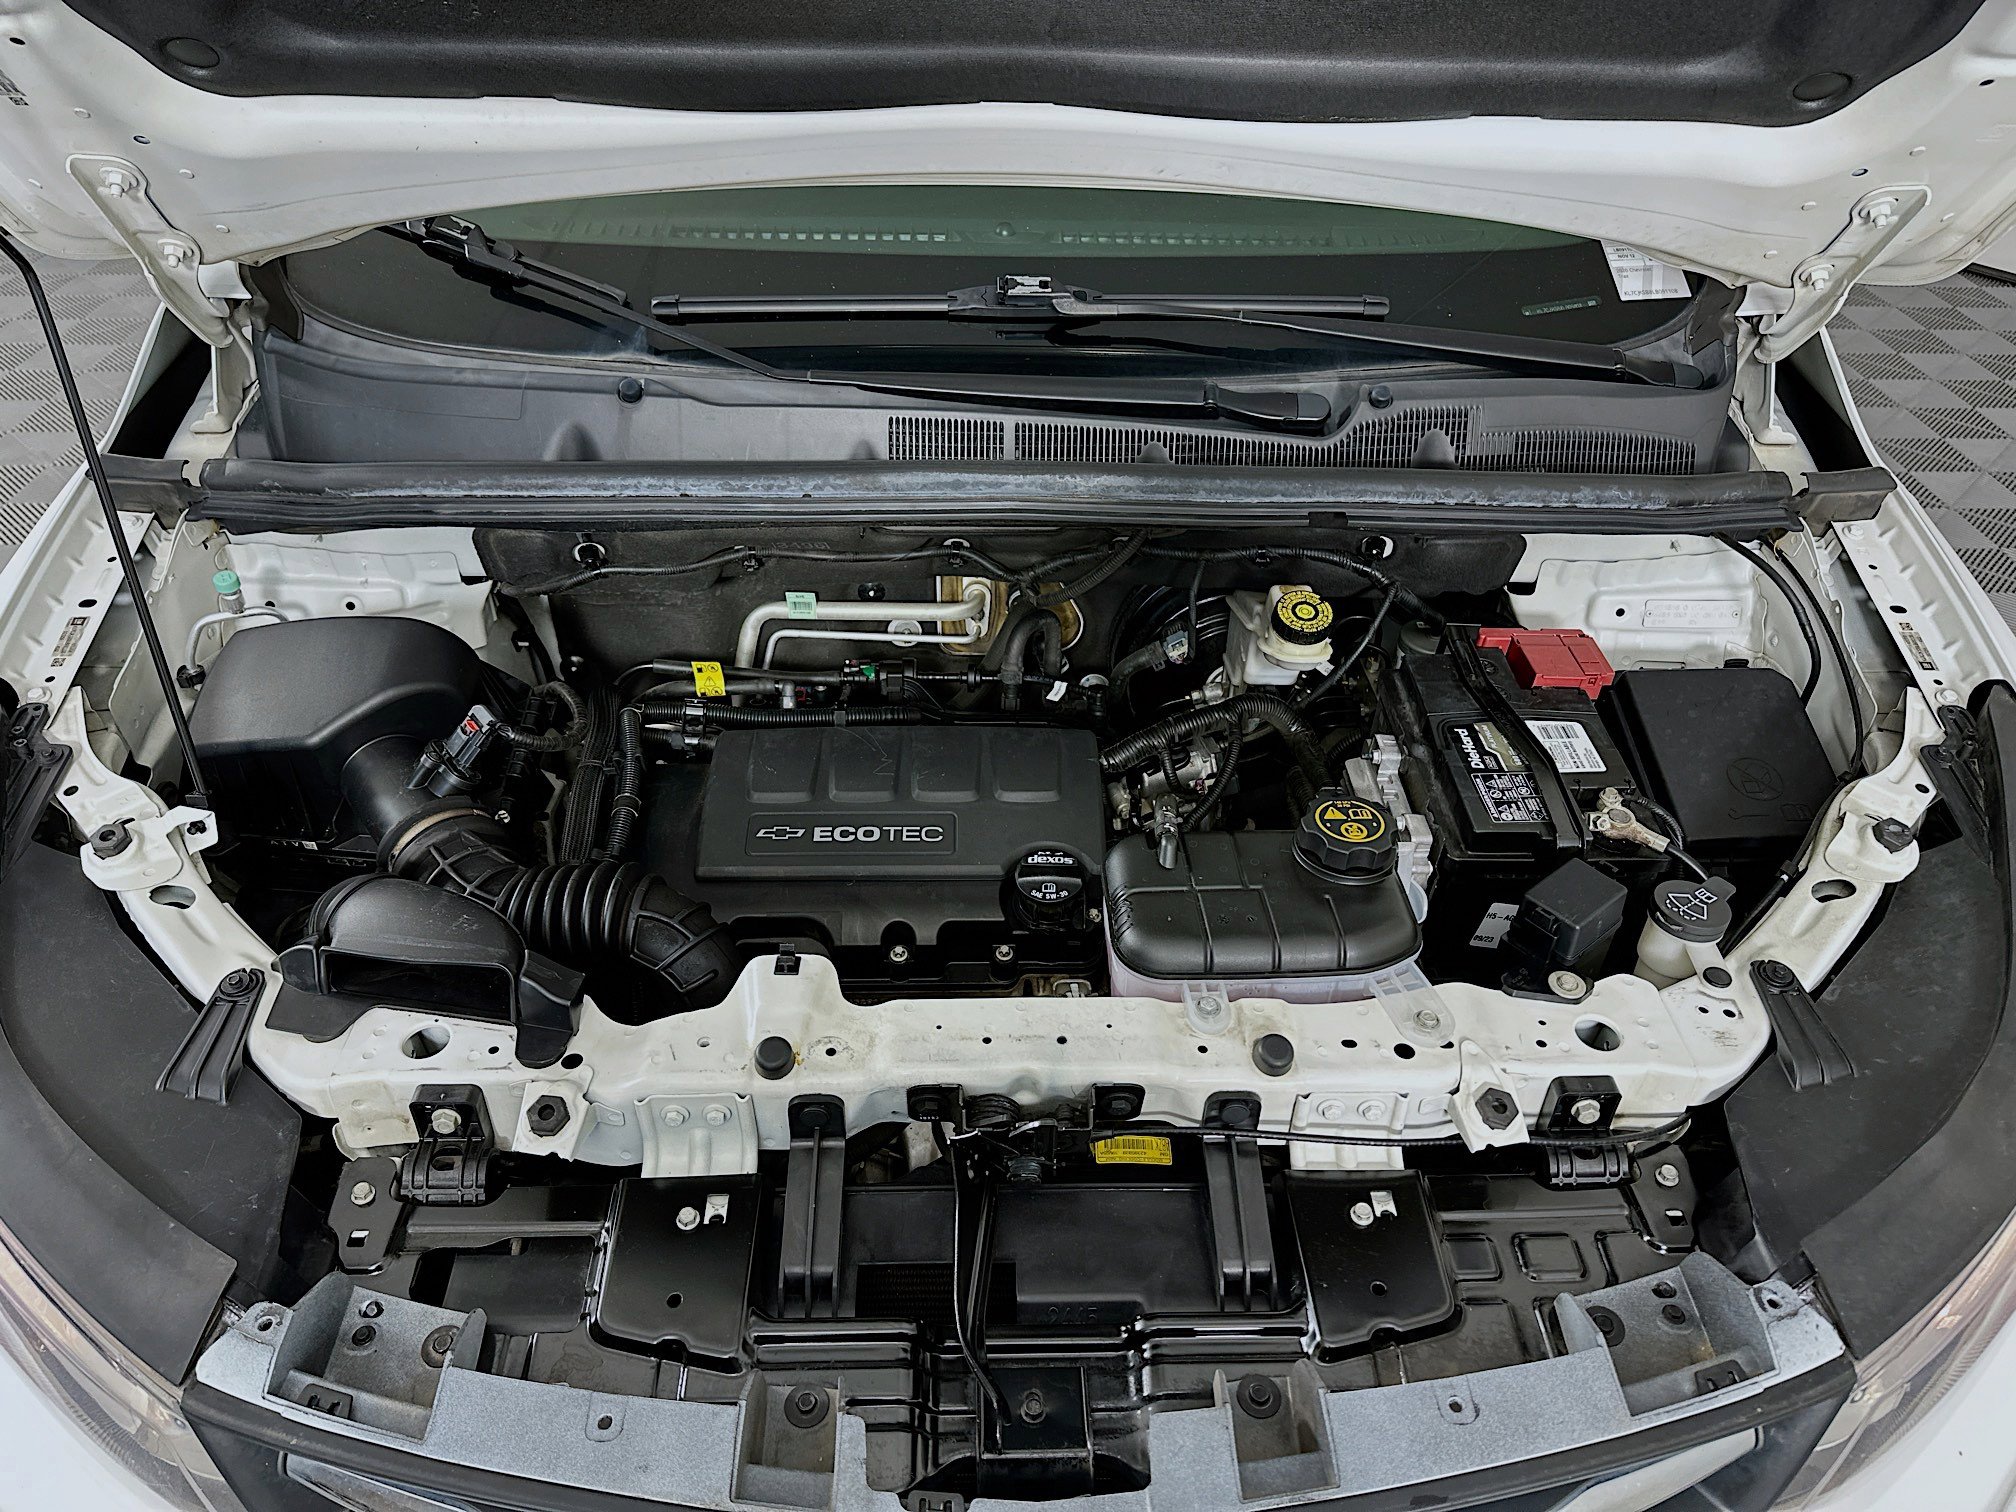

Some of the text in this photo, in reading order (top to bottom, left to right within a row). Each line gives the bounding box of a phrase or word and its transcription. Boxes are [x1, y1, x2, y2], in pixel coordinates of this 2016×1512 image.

[1454, 728, 1485, 769] DieHard
[813, 826, 944, 842] ECOTEC
[1027, 854, 1076, 865] dexos
[1030, 889, 1069, 900] SAE 5W-30
[1473, 934, 1495, 943] 09/23
